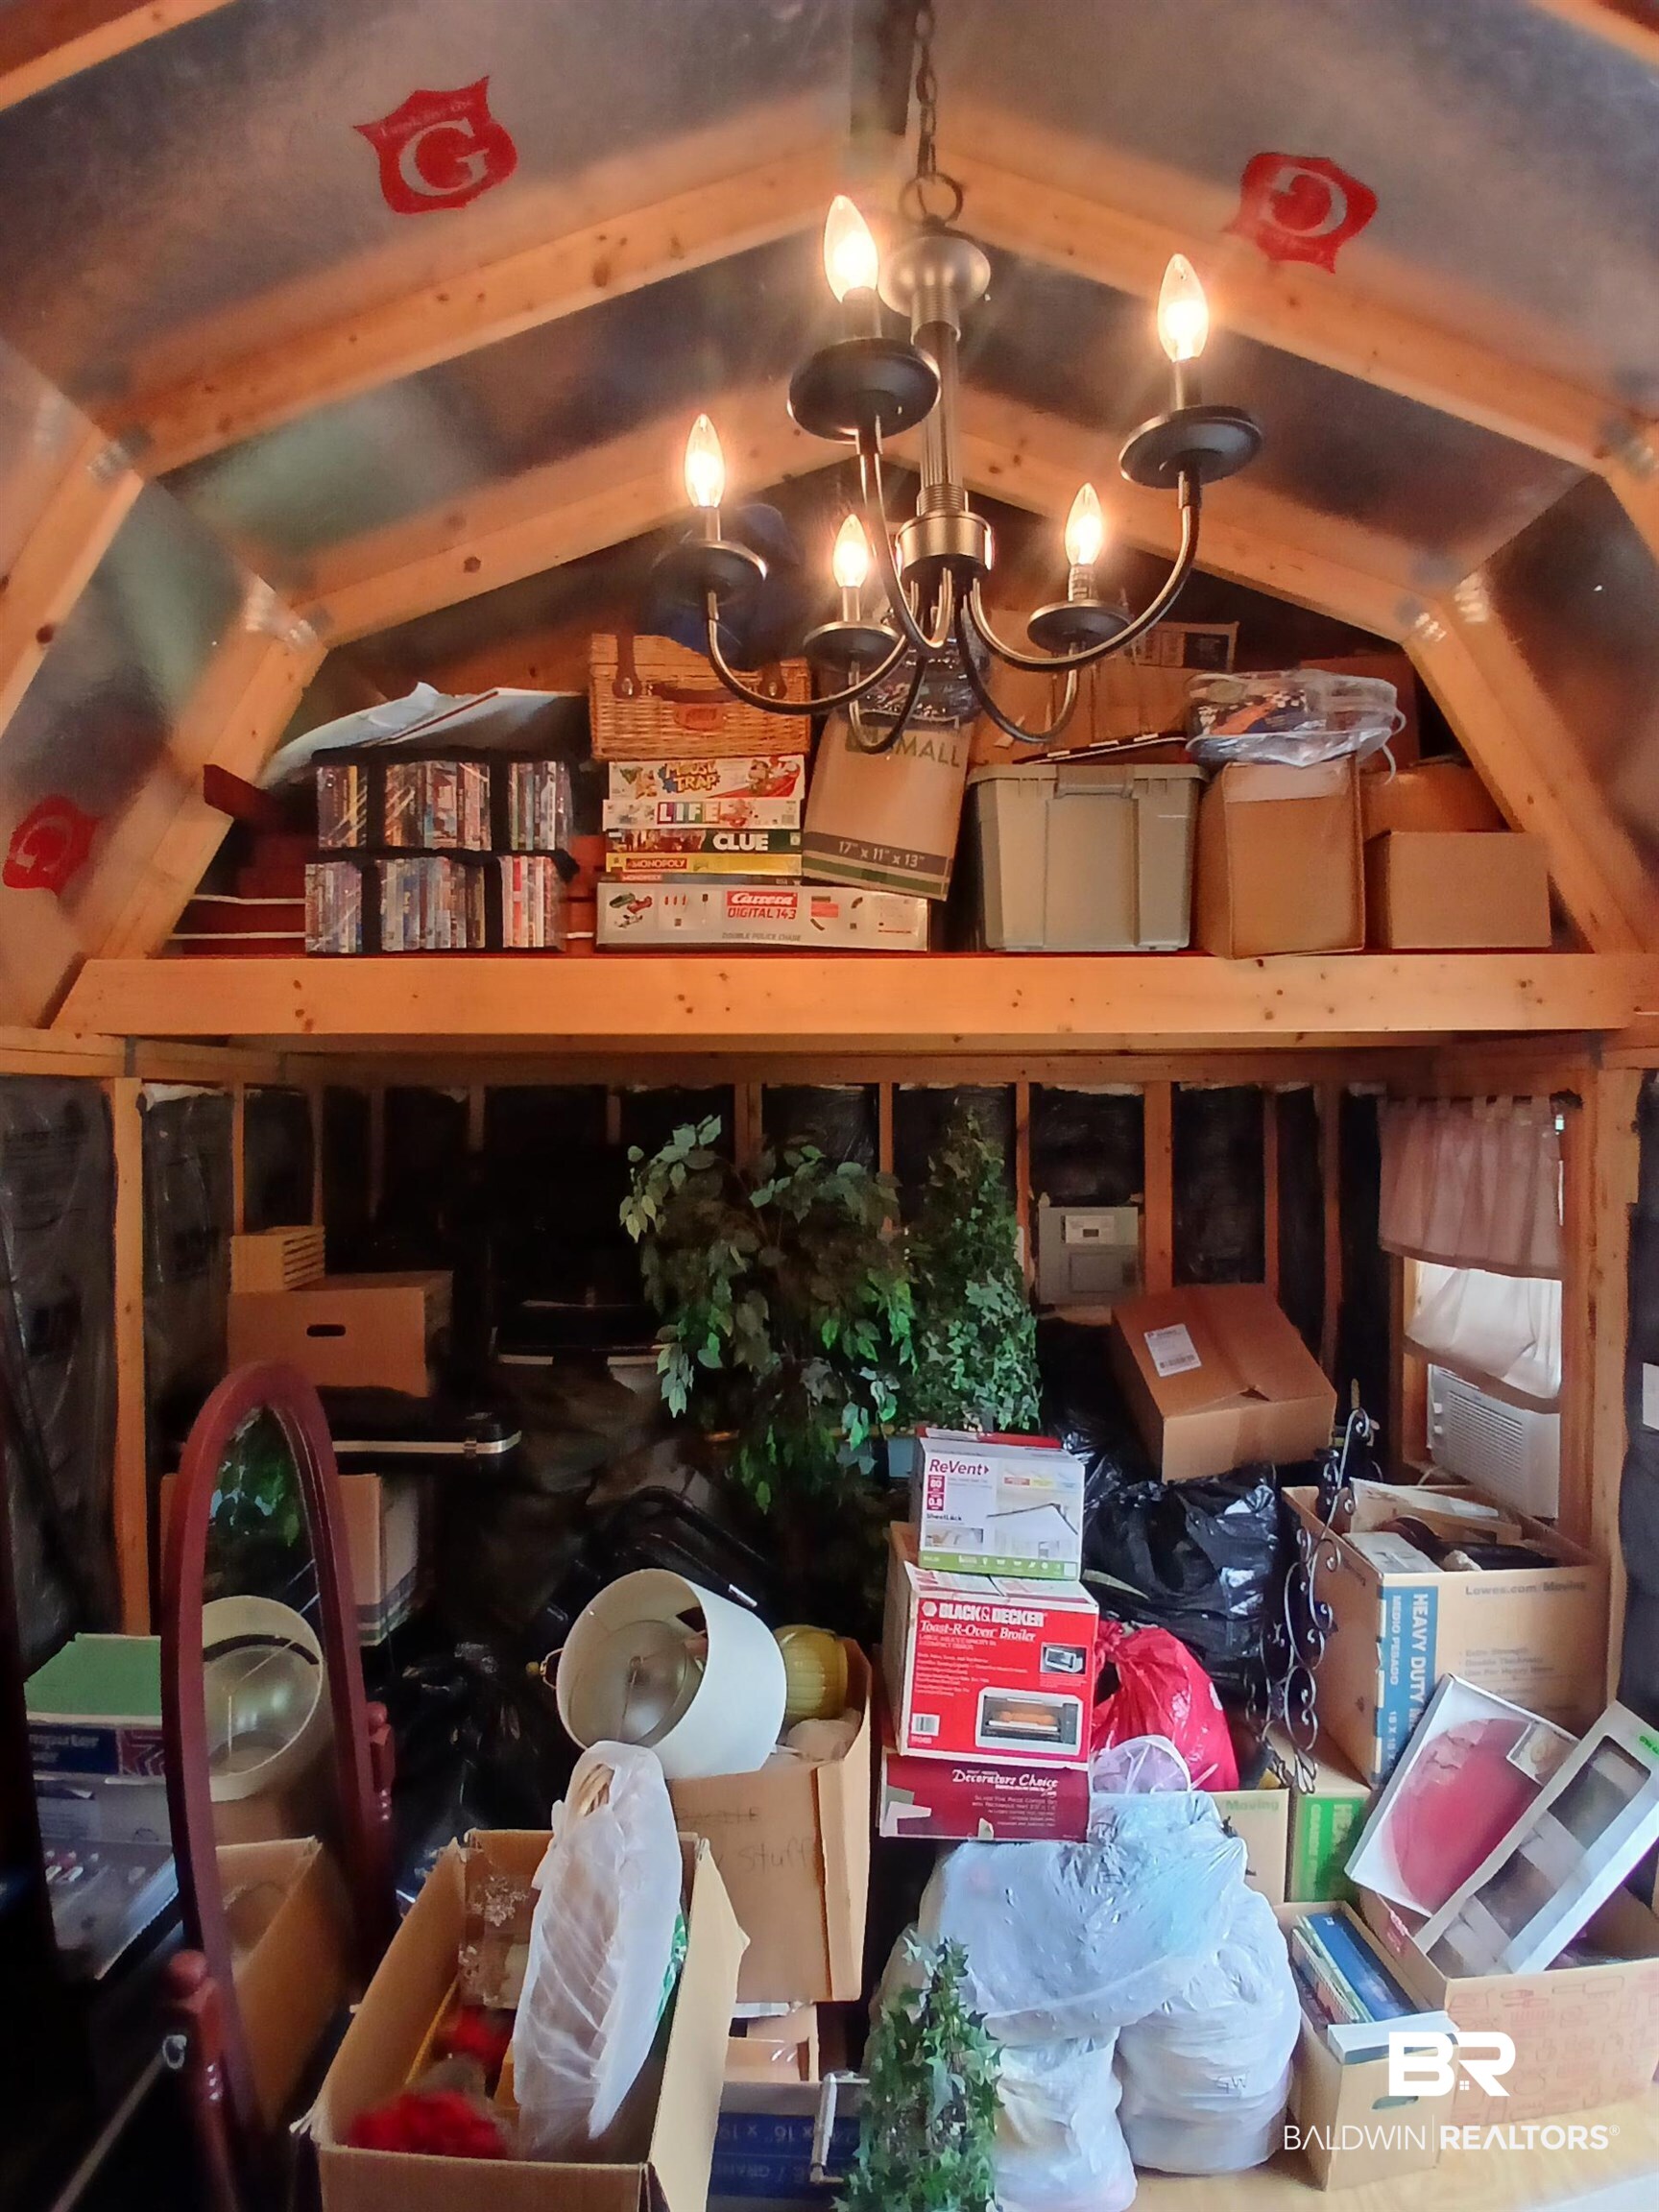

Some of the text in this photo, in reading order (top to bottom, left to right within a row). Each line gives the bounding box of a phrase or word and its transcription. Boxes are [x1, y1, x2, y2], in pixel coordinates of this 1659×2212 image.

[398, 117, 490, 197] G
[890, 733, 960, 768] MALL
[673, 774, 718, 793] TRAP
[659, 803, 720, 823] LIFE
[712, 832, 769, 852] CLUE
[631, 859, 686, 869] MONOPOLY
[731, 892, 795, 905] Carrera
[727, 906, 798, 920] DIGITAL 143
[928, 1458, 983, 1476] ReVent
[1465, 1584, 1537, 1596] Lowes.com
[1391, 1595, 1402, 1634] MEDIO
[1411, 1593, 1429, 1652] HEAVY
[999, 1626, 1037, 1643] Broiler
[1408, 1656, 1427, 1705] DUTY
[1018, 1773, 1059, 1788] Choice
[1225, 1799, 1280, 1812] Moving
